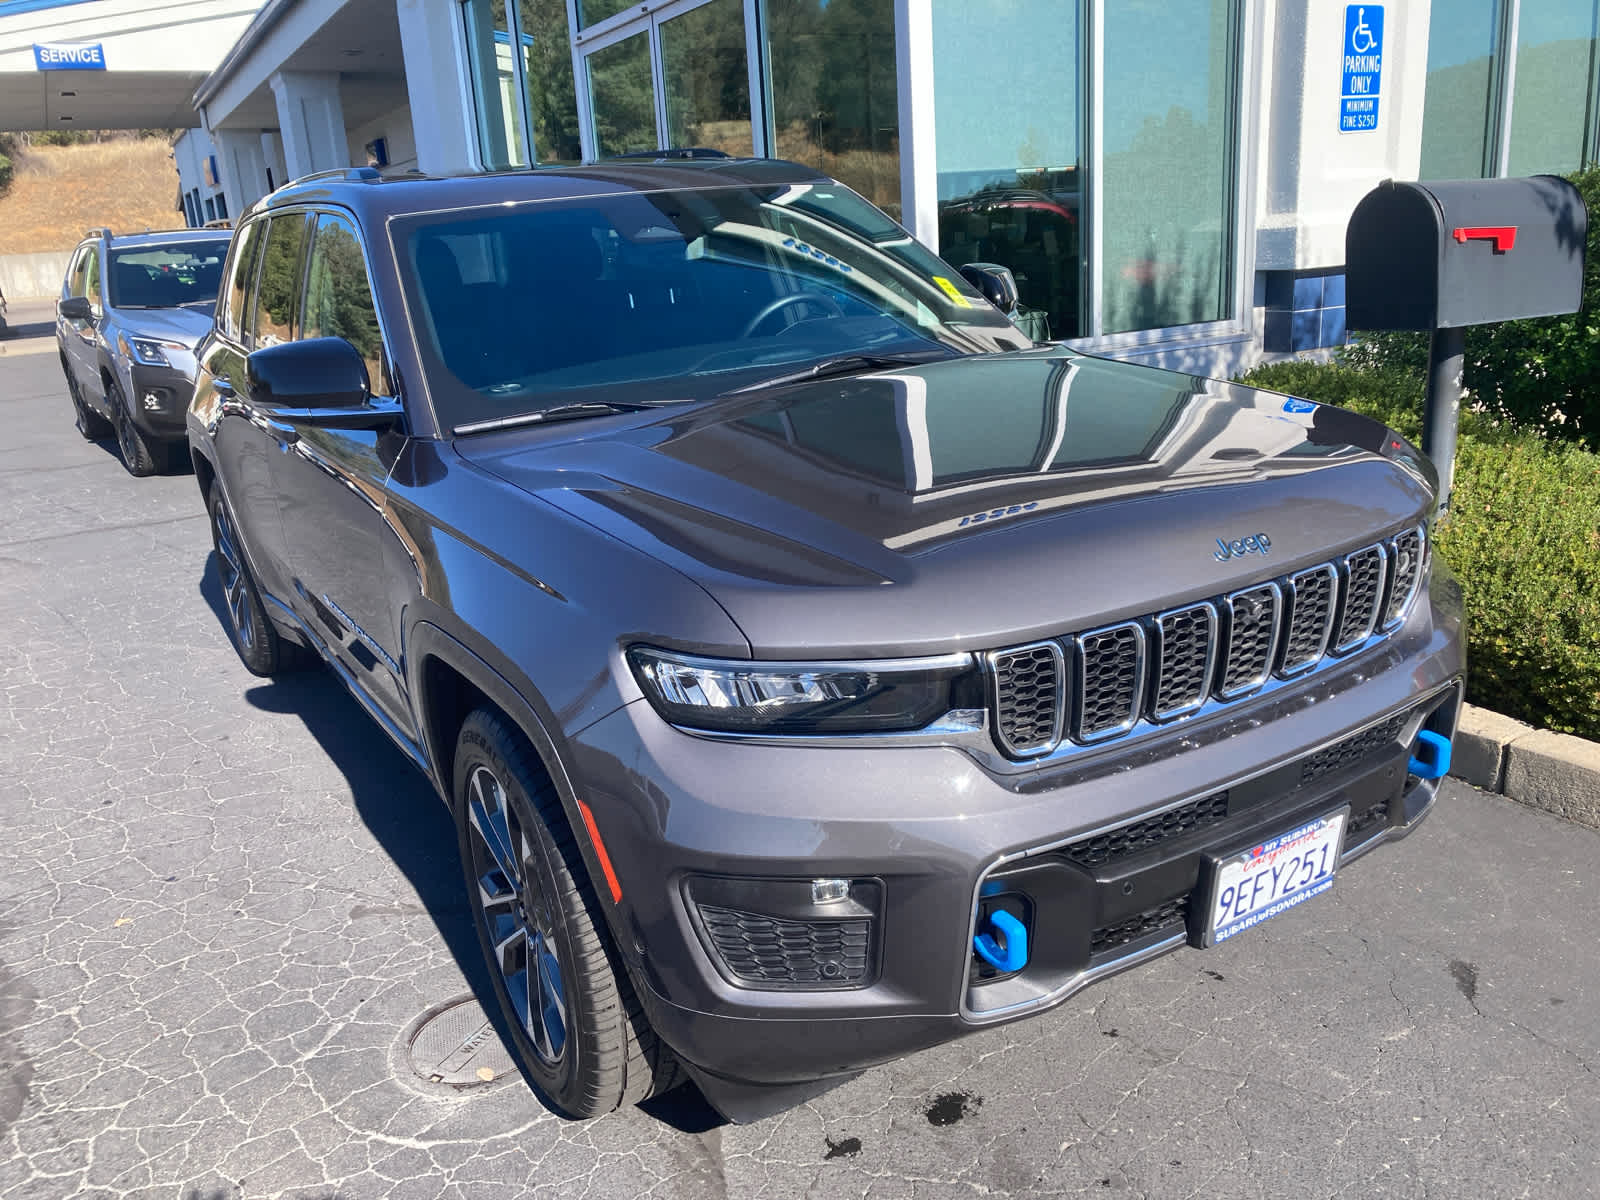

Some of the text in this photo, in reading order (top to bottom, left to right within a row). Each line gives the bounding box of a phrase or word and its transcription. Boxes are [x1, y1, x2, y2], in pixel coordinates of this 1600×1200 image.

[39, 48, 101, 63] SERVICE
[1345, 55, 1380, 73] PARKING
[1351, 75, 1372, 94] ONLY
[1346, 99, 1374, 112] MINIMUM
[1343, 114, 1375, 128] FINE $250
[1214, 532, 1272, 562] Jeep
[1264, 840, 1280, 853] MY
[1215, 842, 1330, 927] 9EFY251
